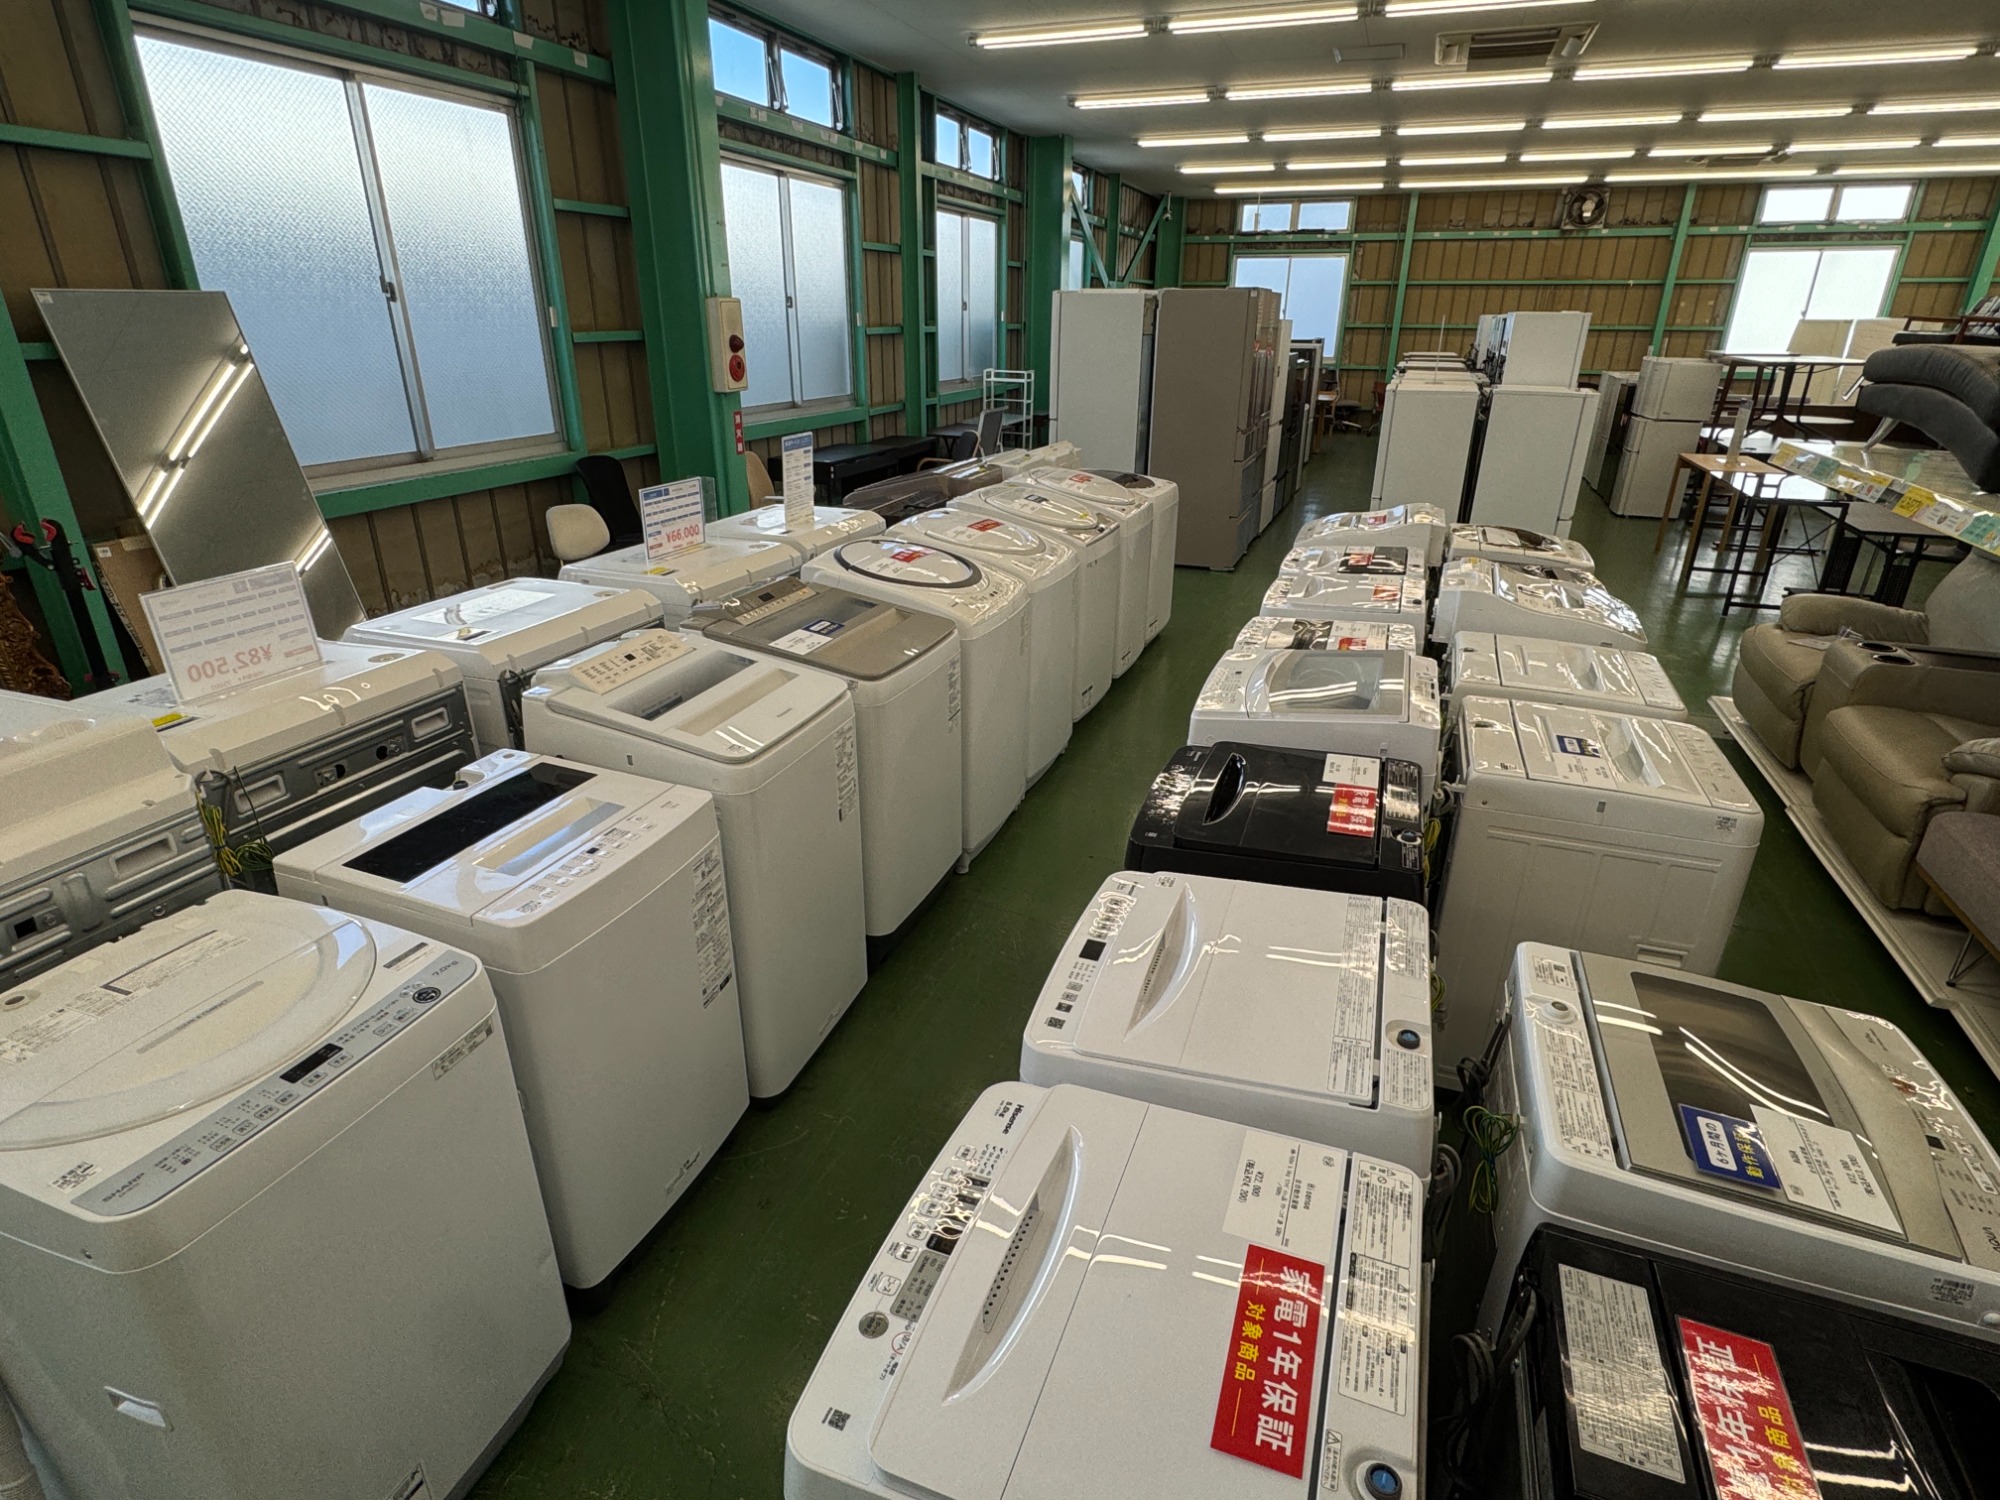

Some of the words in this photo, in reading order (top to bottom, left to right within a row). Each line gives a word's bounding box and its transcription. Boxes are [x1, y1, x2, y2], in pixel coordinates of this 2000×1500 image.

[666, 524, 700, 544] ¥66,000
[1002, 1104, 1024, 1135] Hisense
[102, 1172, 145, 1202] SHARP
[1234, 1300, 1267, 1382] 対象商品
[1255, 1266, 1312, 1457] 家電1年保証
